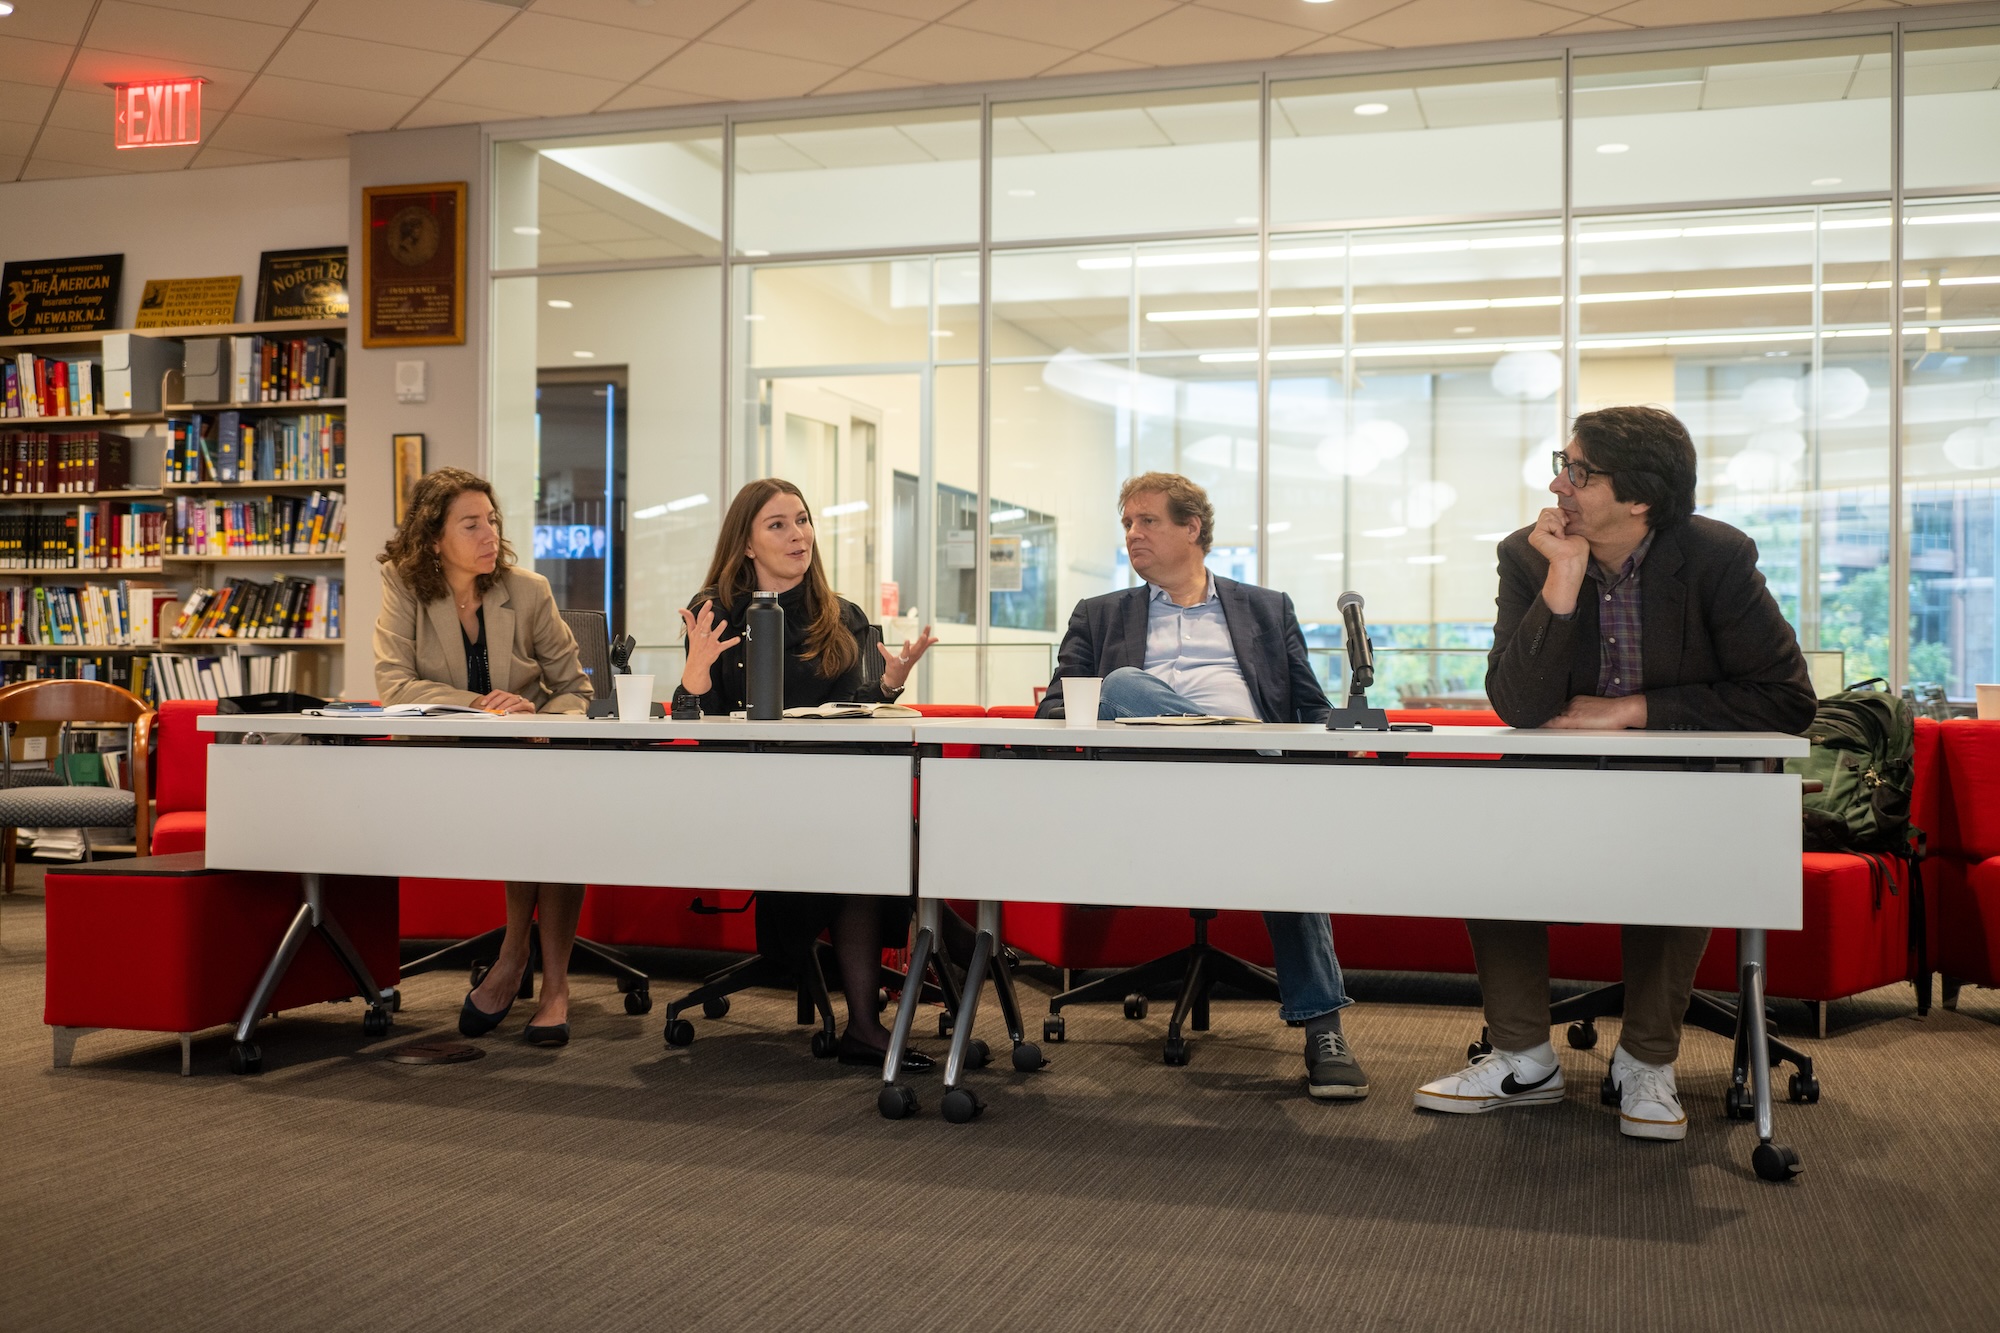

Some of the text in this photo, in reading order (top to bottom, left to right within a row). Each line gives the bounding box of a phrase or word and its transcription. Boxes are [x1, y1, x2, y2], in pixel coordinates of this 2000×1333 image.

[127, 84, 191, 143] EXIT
[68, 264, 104, 272] REPRESENTED
[31, 274, 110, 296] THE AMERICAN
[272, 265, 324, 294] NORTH
[42, 295, 102, 306] Insurance Company
[176, 292, 208, 300] INSURED
[166, 307, 230, 317] HARTFORD
[273, 306, 323, 317] INSURANCE
